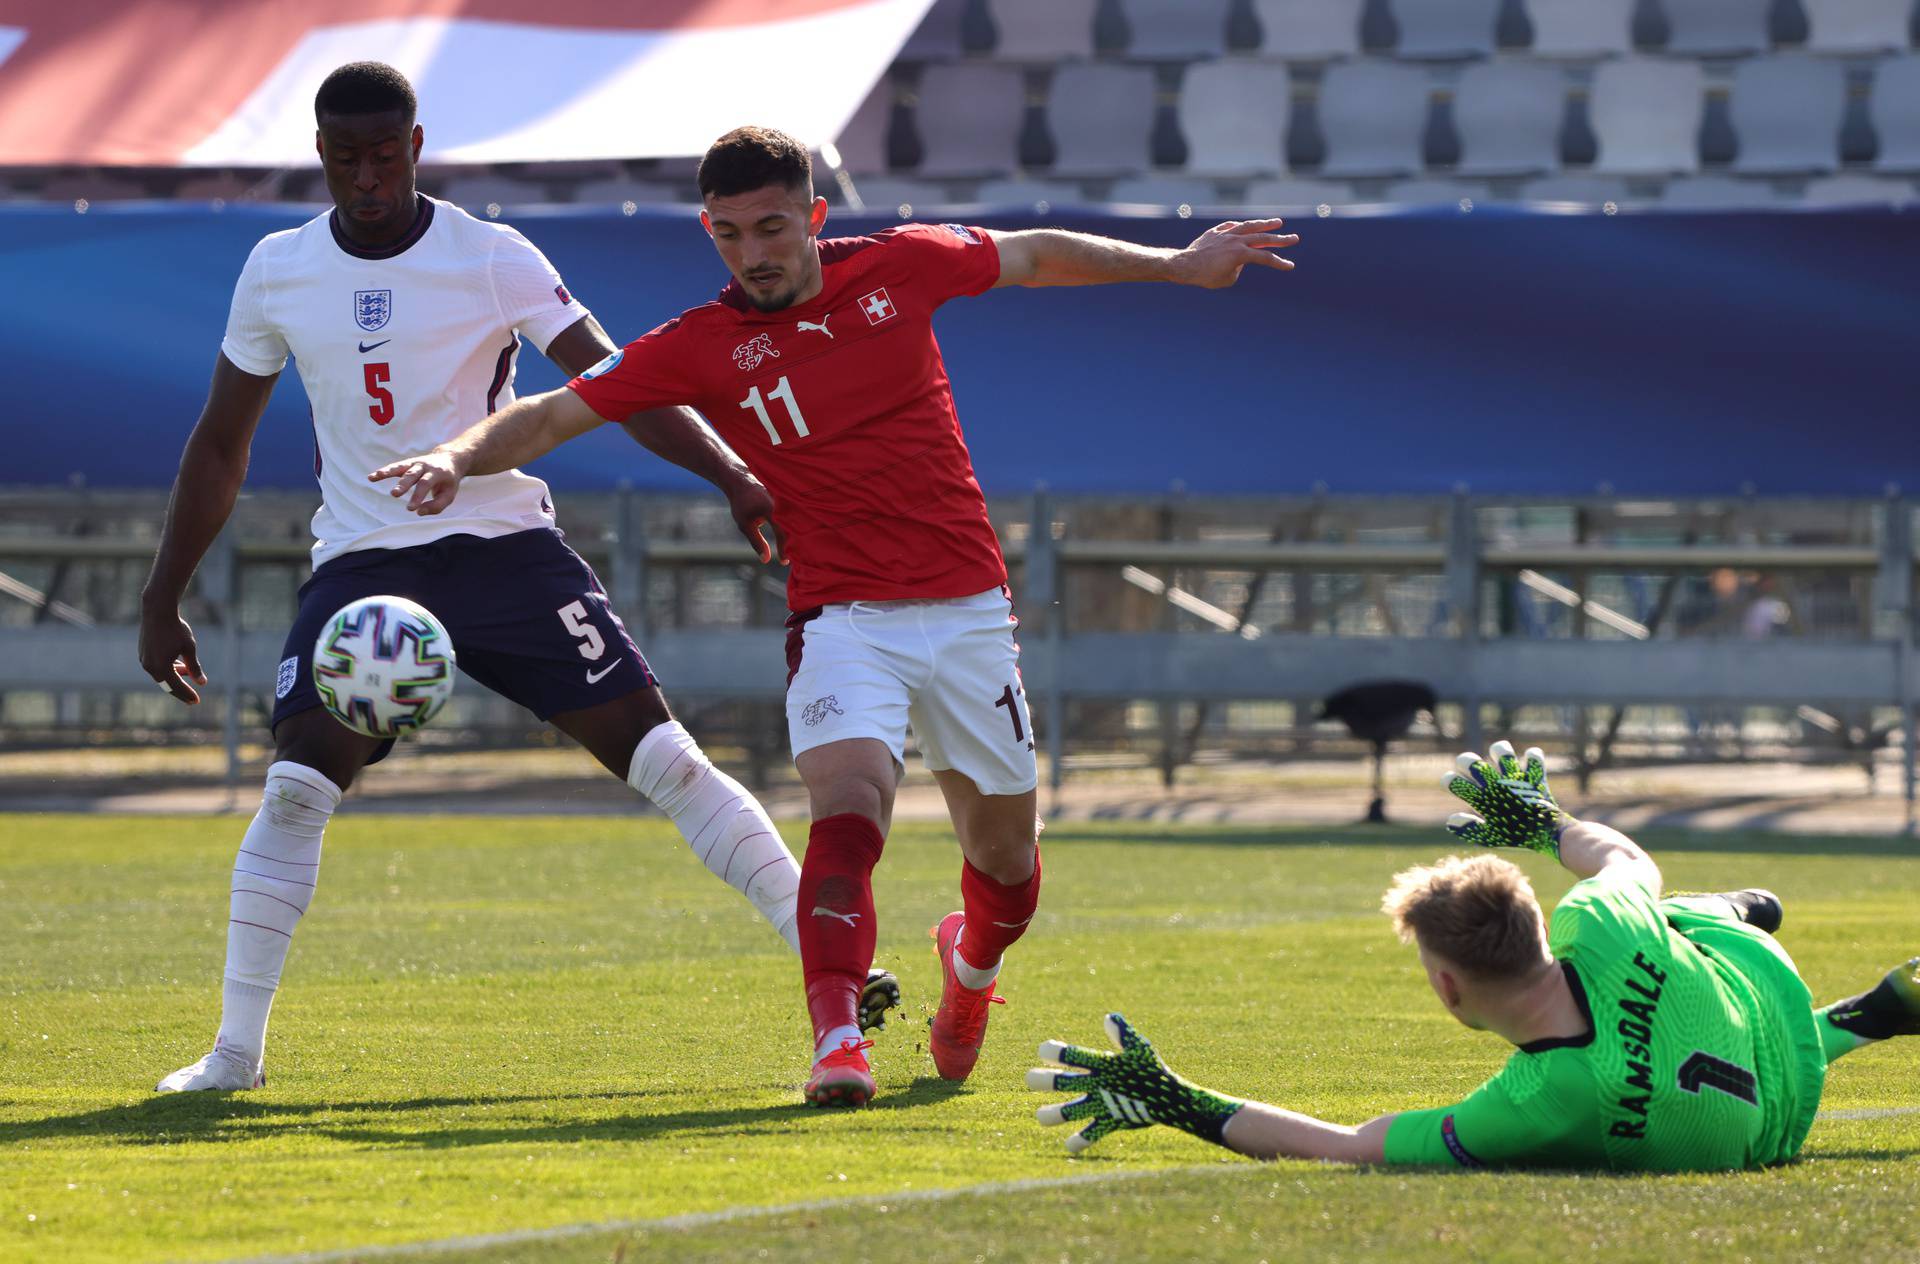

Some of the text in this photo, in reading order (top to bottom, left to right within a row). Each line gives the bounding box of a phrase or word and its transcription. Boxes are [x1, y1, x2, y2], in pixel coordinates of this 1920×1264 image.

[364, 362, 395, 426] 5
[739, 375, 810, 446] 11
[557, 599, 606, 661] 5
[995, 684, 1023, 743] 1
[1608, 951, 1667, 1139] RAMSDALE
[1676, 1049, 1760, 1107] 1
